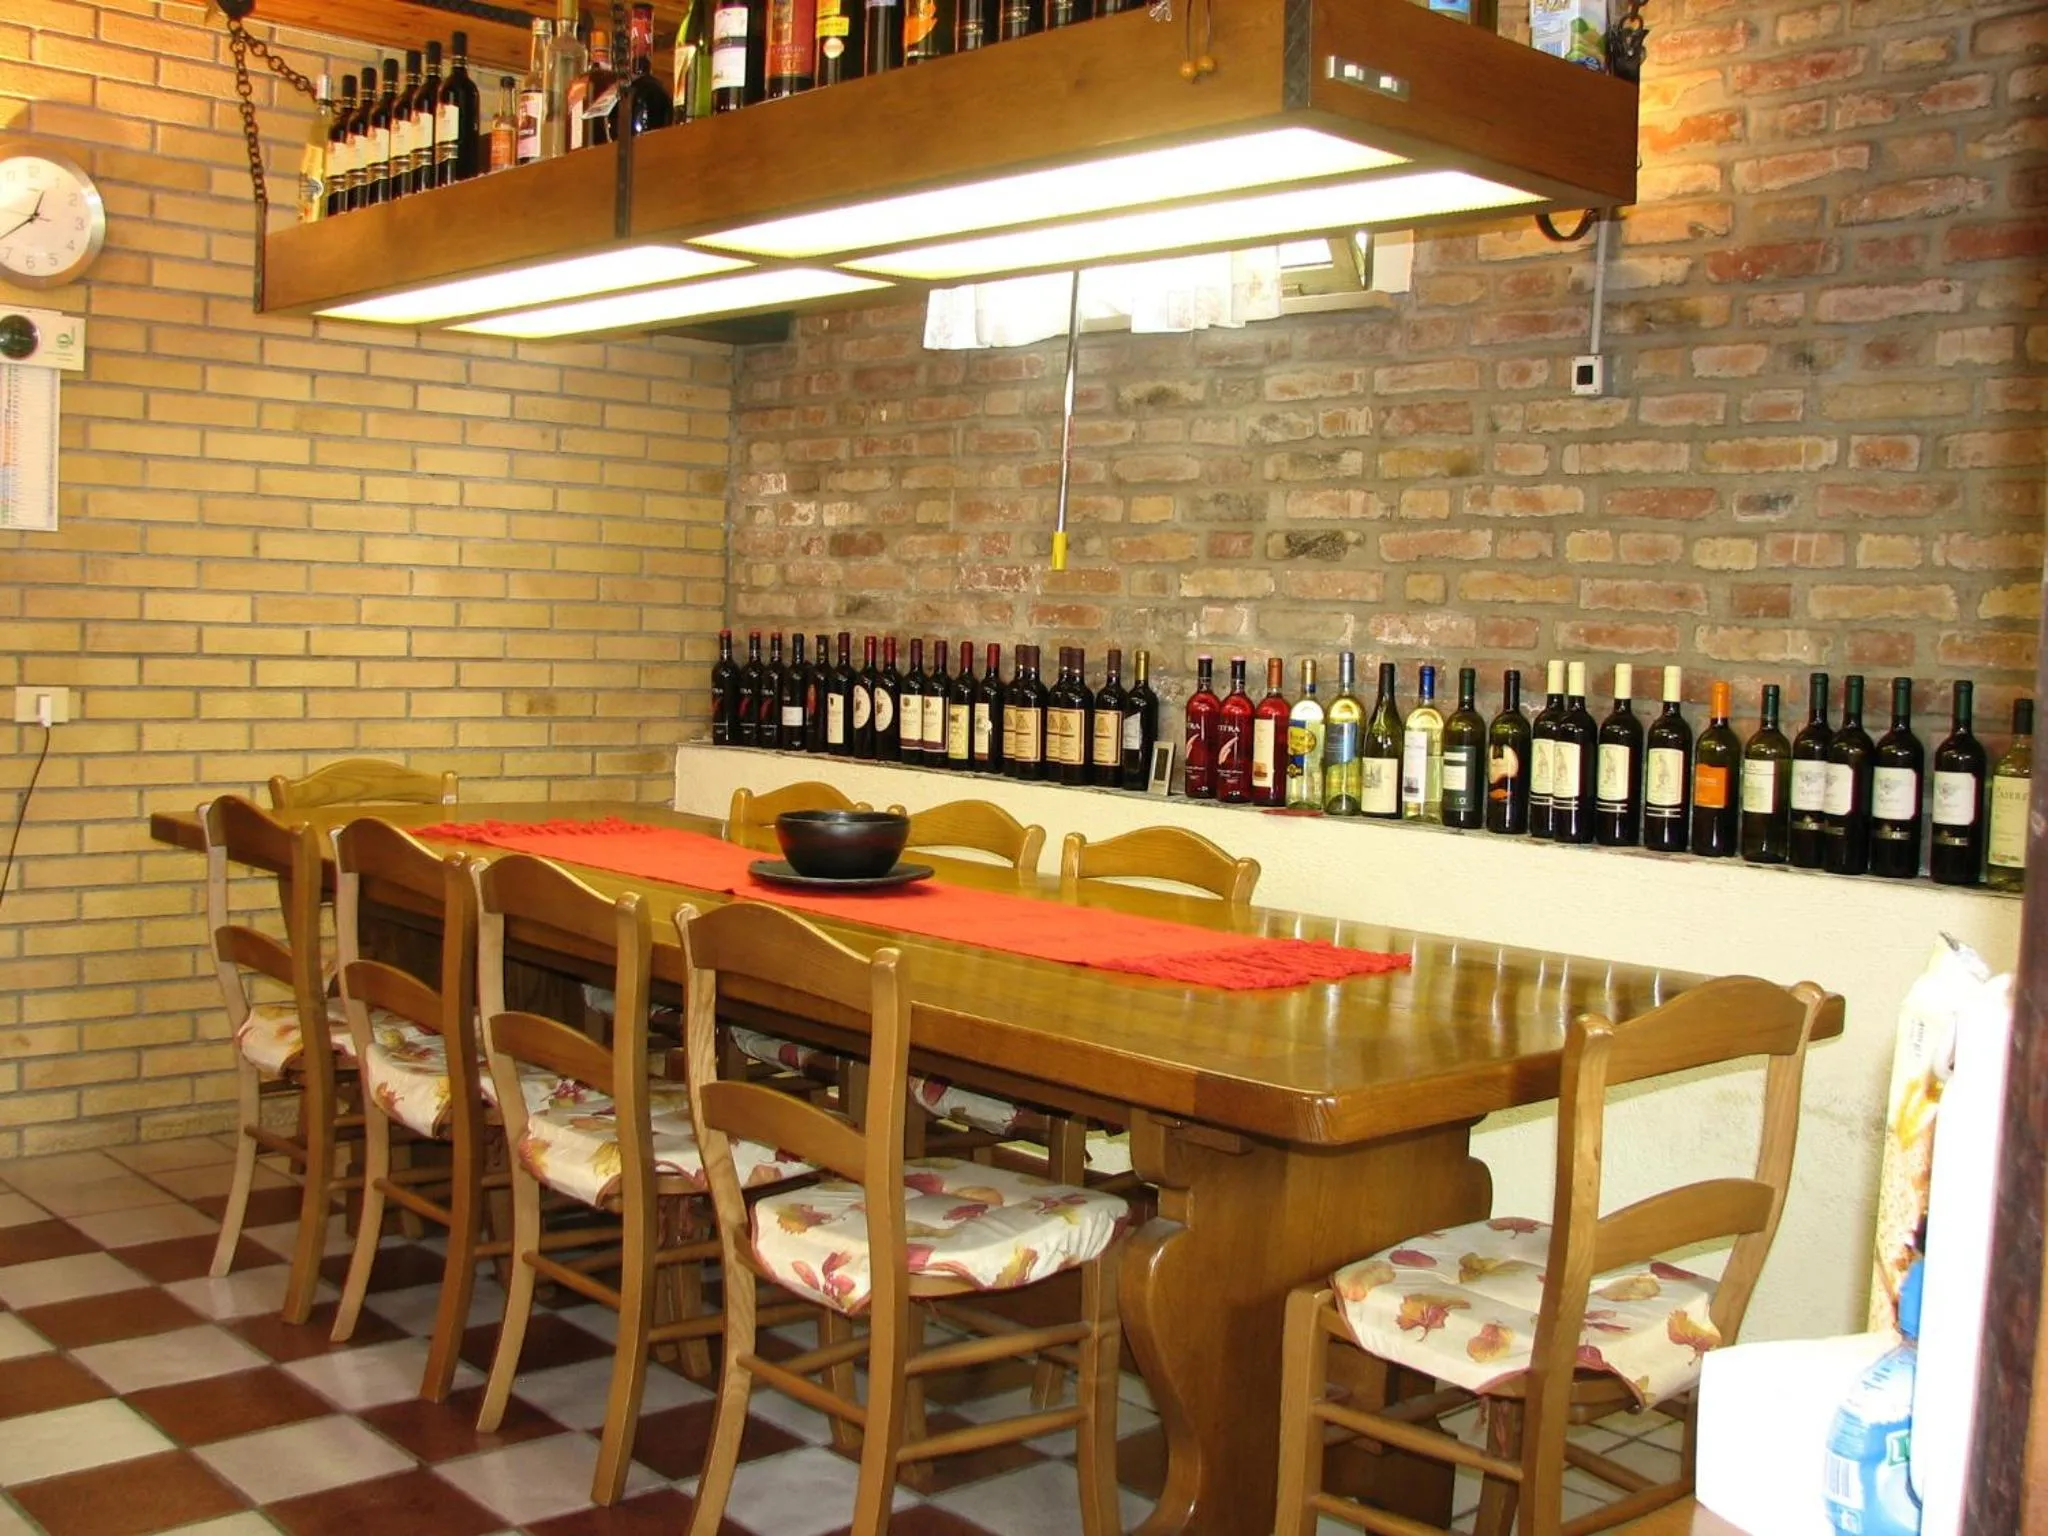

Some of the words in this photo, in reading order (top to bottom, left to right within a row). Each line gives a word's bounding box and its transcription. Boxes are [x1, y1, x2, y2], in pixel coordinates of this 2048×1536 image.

[68, 192, 78, 207] 2
[75, 216, 85, 231] 3
[66, 239, 76, 251] 4
[4, 246, 14, 260] 7
[48, 252, 59, 267] 5
[26, 255, 36, 270] 6
